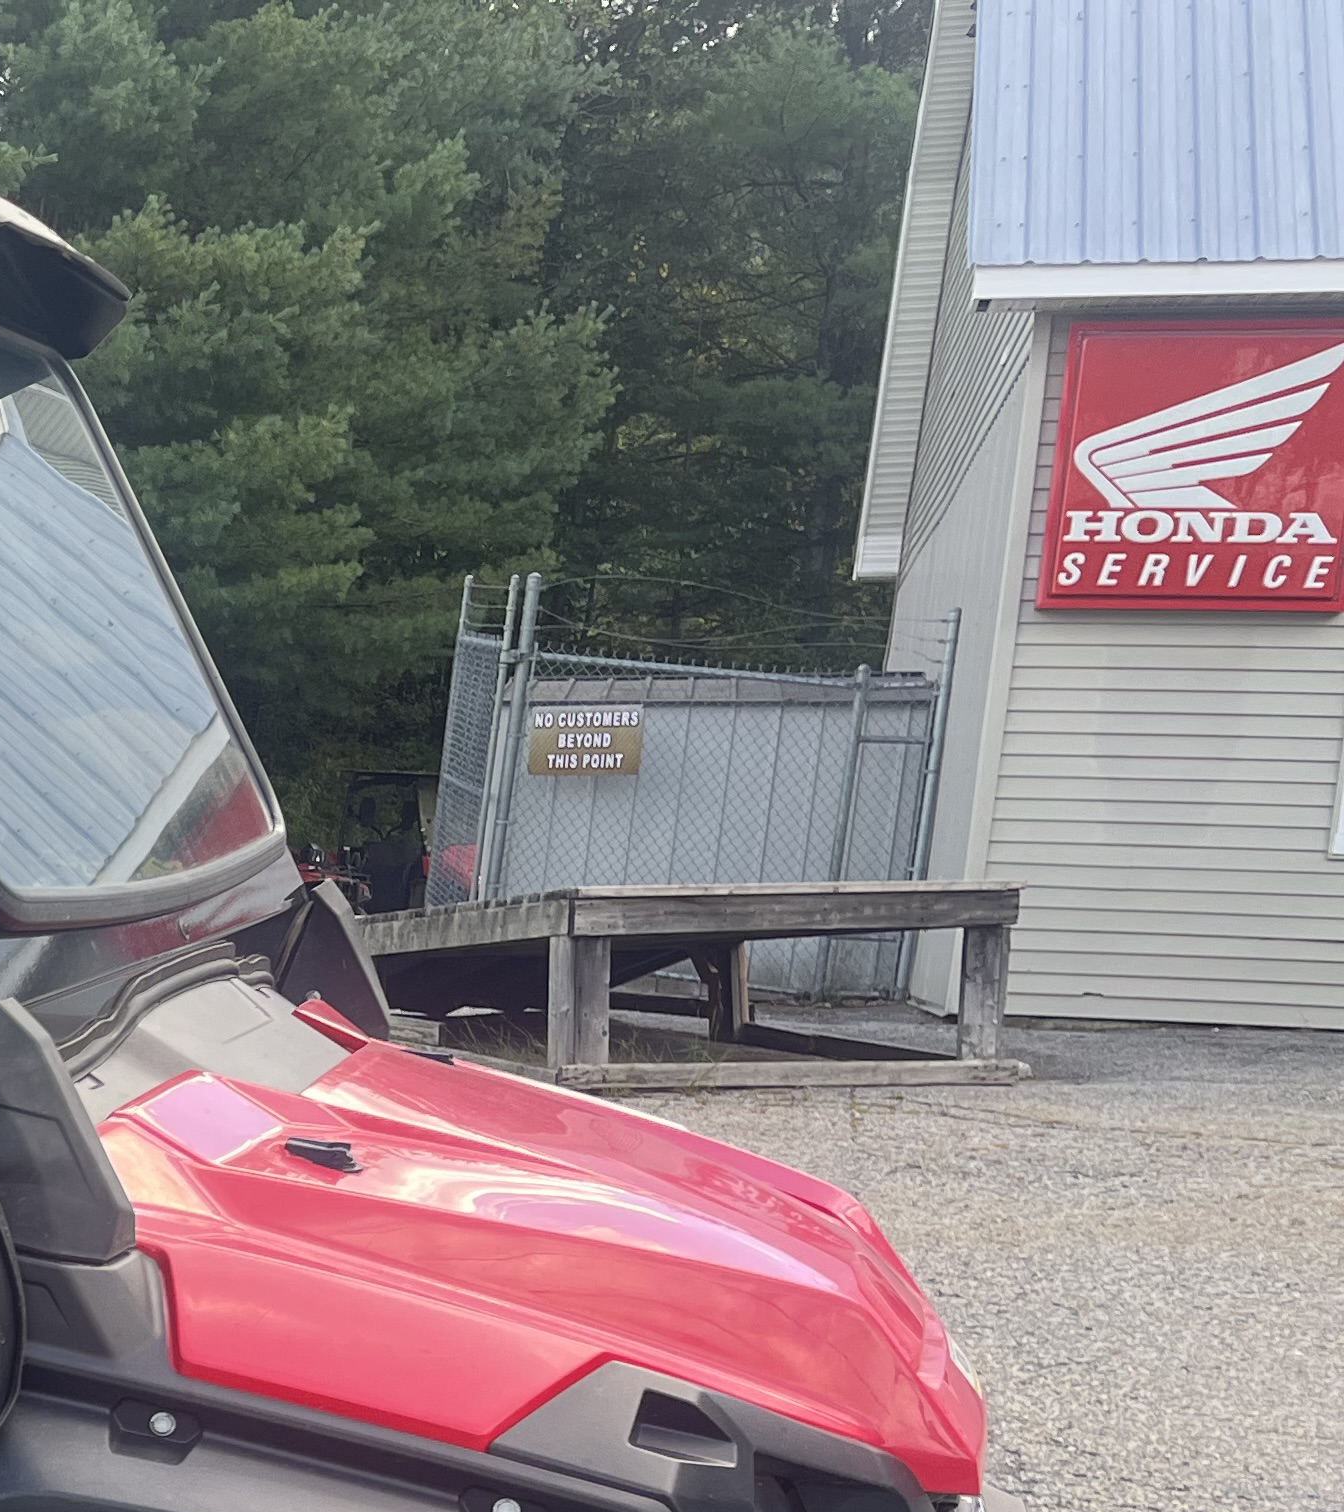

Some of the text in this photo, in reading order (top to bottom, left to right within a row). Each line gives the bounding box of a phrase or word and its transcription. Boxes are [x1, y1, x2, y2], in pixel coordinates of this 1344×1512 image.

[1062, 510, 1338, 544] HONDA
[1056, 552, 1335, 589] SERVICE
[534, 711, 639, 728] NO CUSTOMERS
[557, 733, 611, 748] BEYOND
[547, 753, 624, 769] THIS POINT
